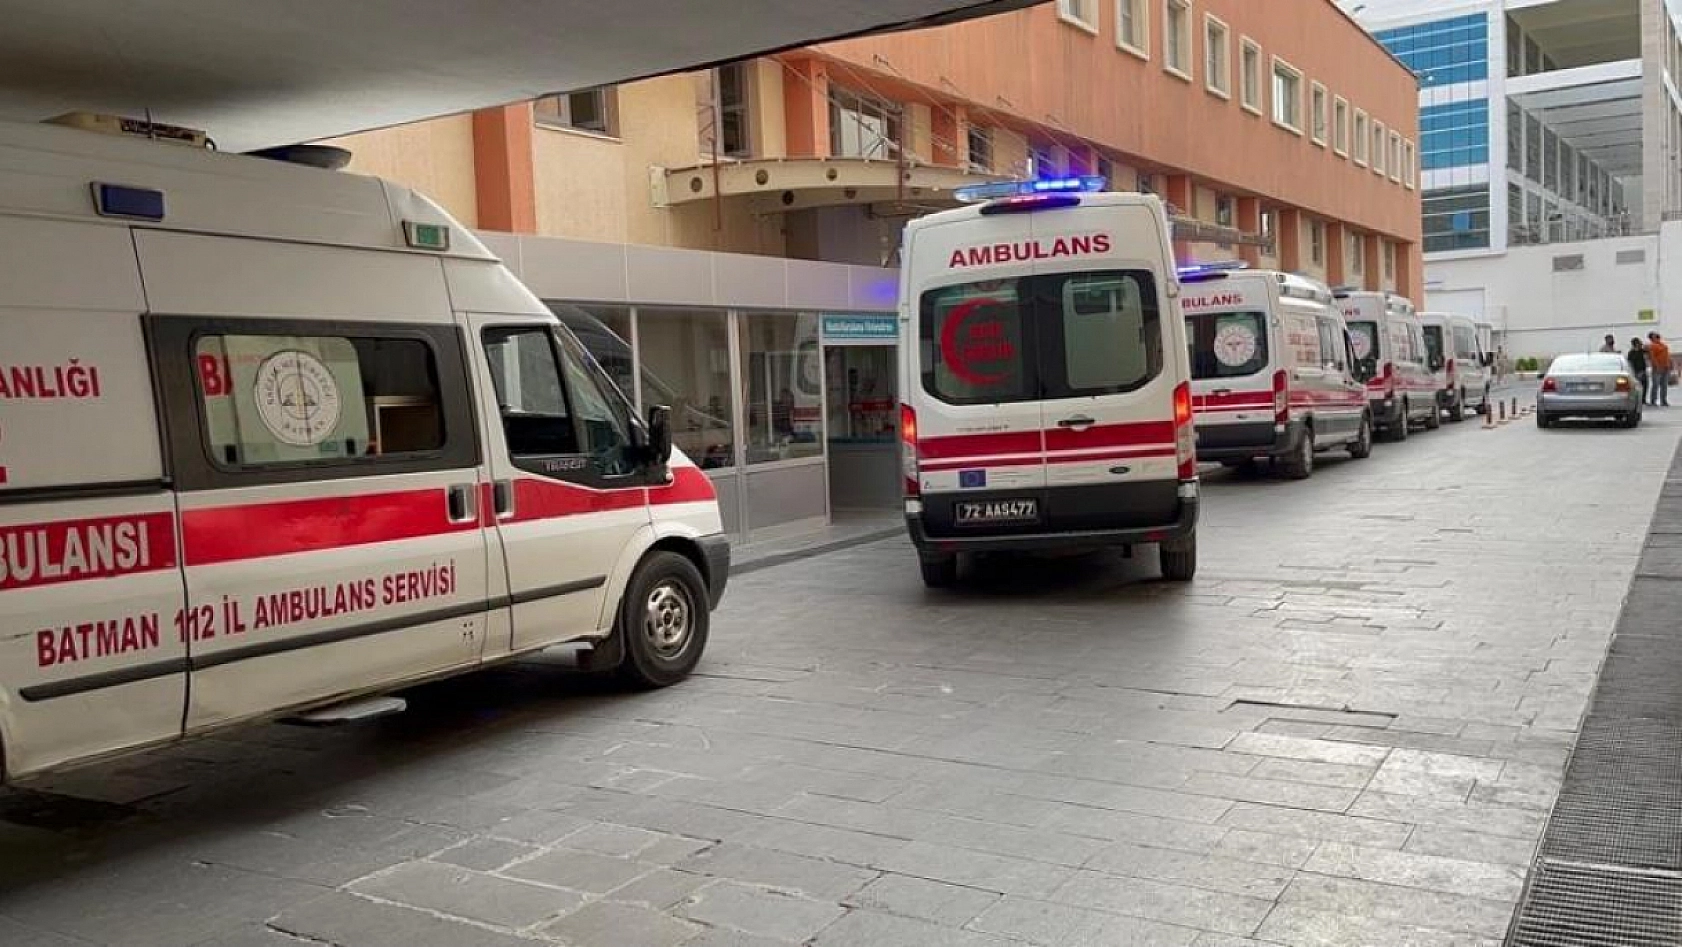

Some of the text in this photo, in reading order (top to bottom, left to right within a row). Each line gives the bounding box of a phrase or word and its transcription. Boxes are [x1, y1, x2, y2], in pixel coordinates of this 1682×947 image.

[949, 234, 1110, 268] AMBULANS
[963, 503, 980, 519] 72
[37, 557, 457, 668] BATMAN 112 İL AMBULANS SERVİSİ
